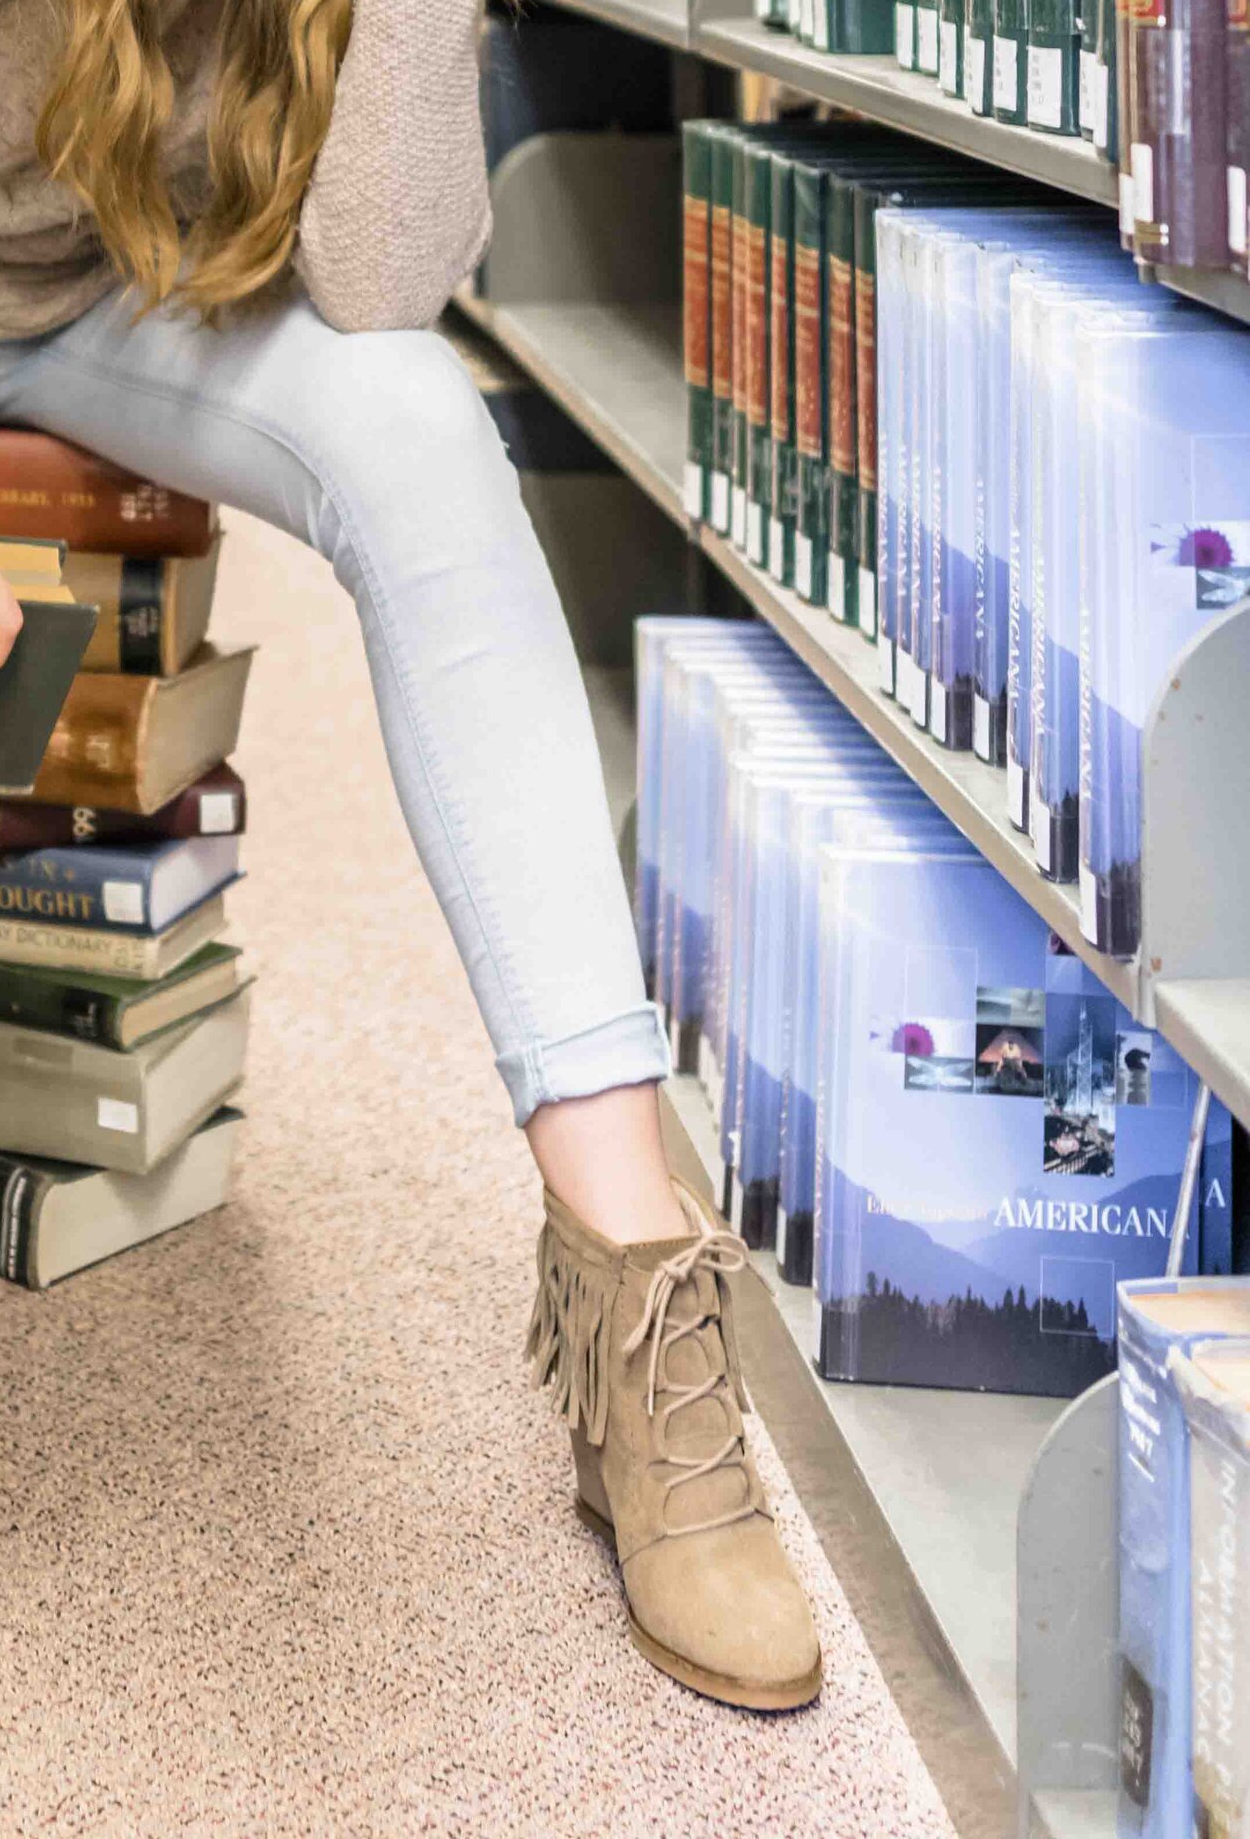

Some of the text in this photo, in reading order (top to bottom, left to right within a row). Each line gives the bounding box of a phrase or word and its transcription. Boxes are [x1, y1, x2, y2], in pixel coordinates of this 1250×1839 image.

[975, 475, 985, 641] AMERICANA
[16, 924, 113, 956] DICTIONARY
[1197, 1558, 1213, 1761] ALMANAC
[1216, 1459, 1237, 1747] INFORMATION
